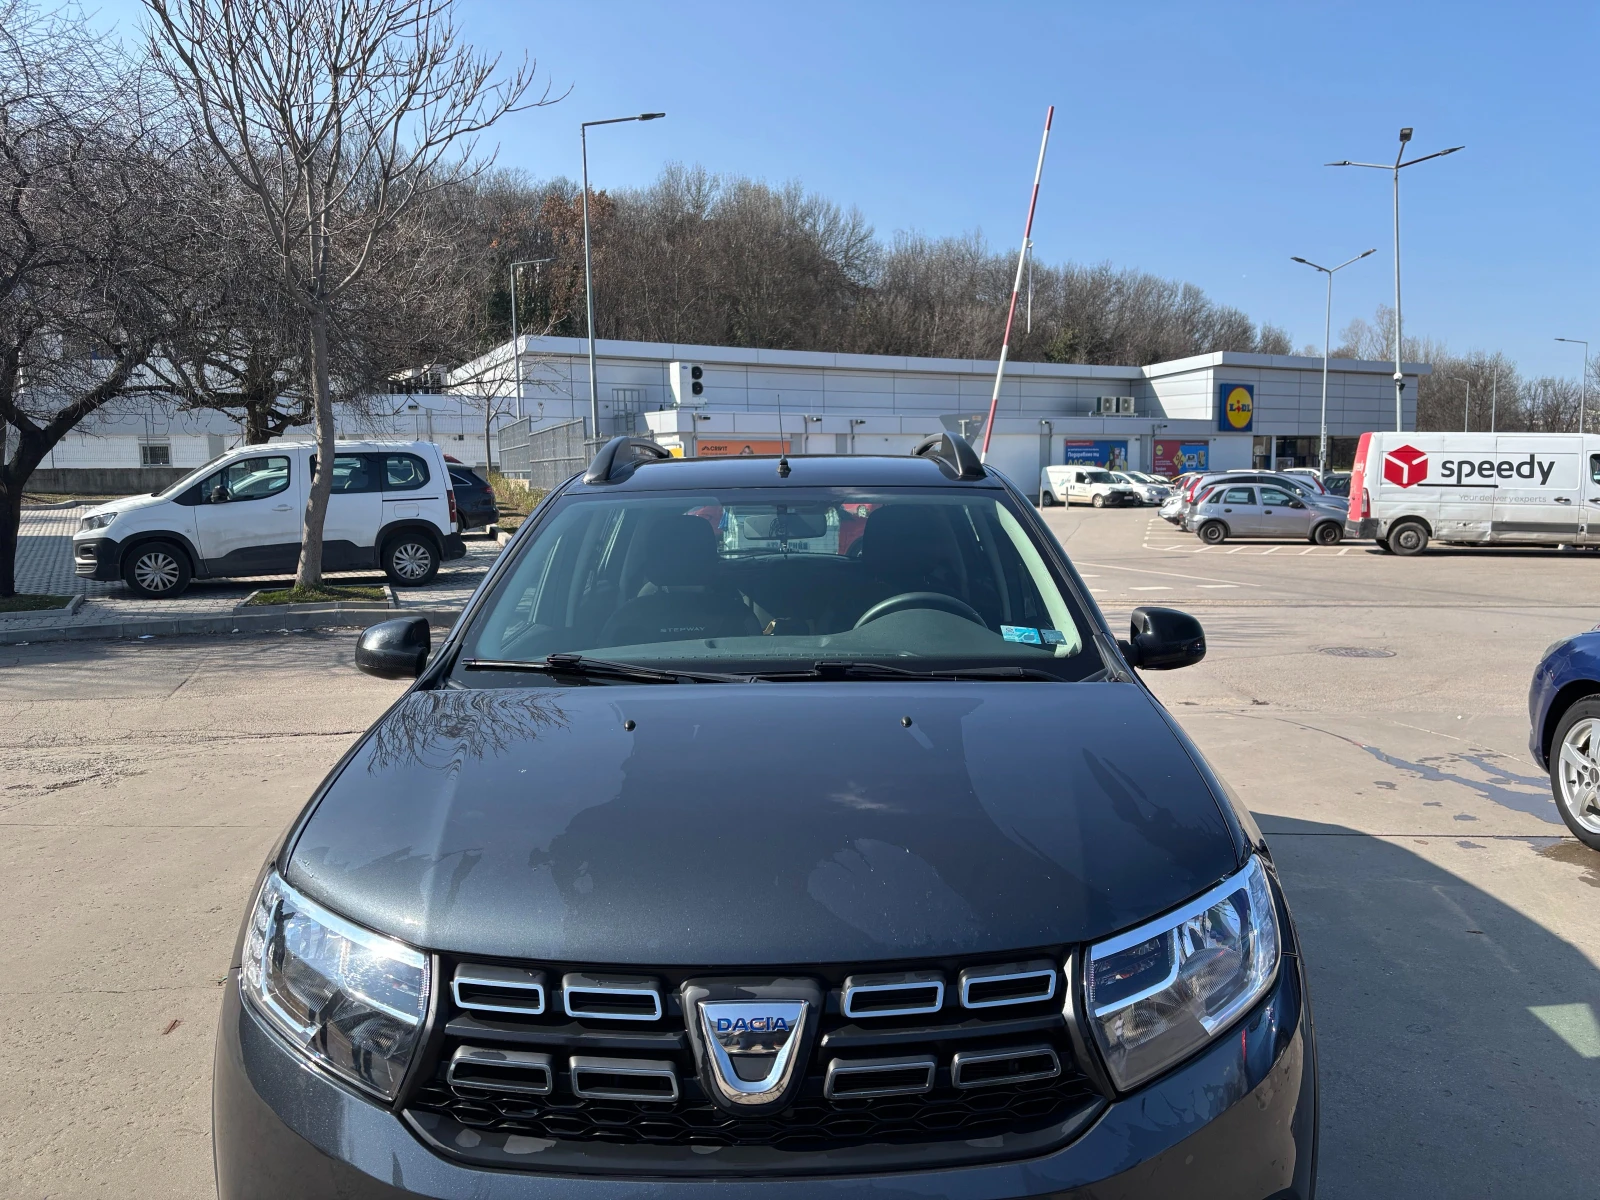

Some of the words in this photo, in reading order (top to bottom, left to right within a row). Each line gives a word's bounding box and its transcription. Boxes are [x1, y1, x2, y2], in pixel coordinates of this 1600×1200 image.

[1229, 400, 1251, 413] LIDL
[1441, 454, 1555, 485] speedy
[717, 1017, 790, 1032] DACIA
